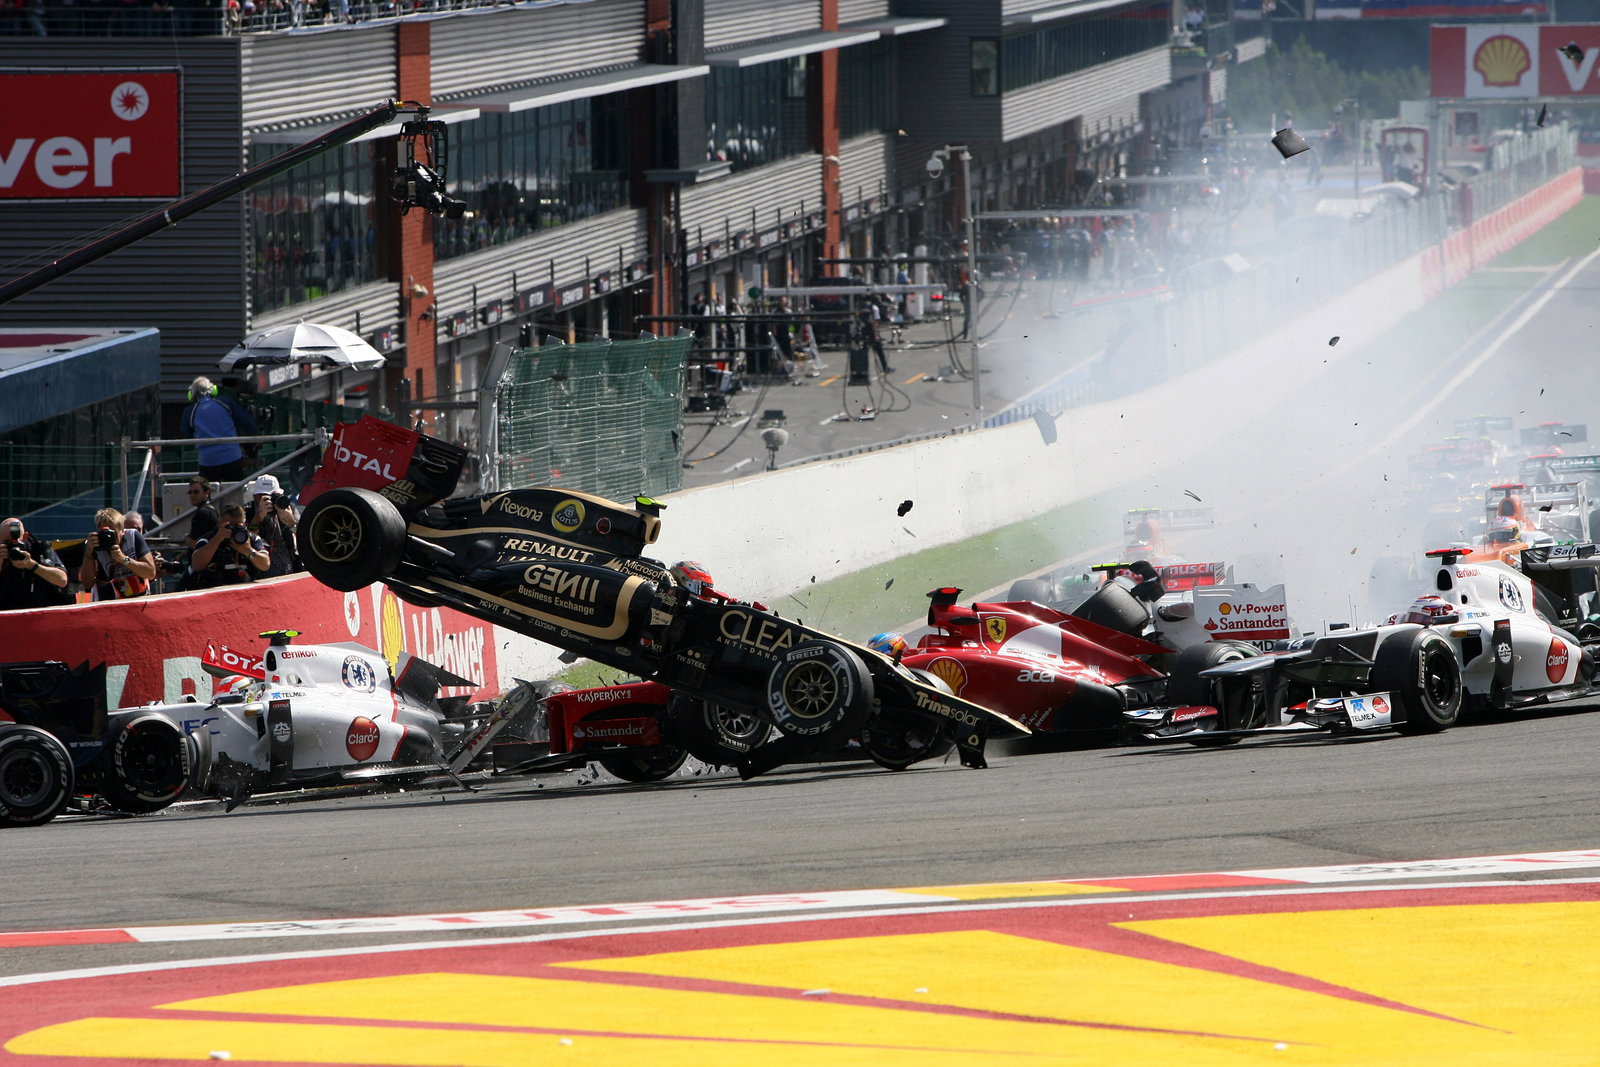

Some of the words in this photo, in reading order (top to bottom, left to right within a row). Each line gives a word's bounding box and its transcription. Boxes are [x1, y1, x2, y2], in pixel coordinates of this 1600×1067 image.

[333, 439, 397, 482] TOTAL
[499, 497, 543, 523] Rexona
[556, 512, 579, 526] LOTUS
[504, 537, 595, 564] RENAULT
[623, 558, 667, 582] Microsoft
[523, 564, 600, 604] GENII
[518, 584, 553, 604] Business
[554, 597, 595, 616] Exchange
[1233, 603, 1285, 614] V-Power
[719, 609, 815, 653] CLEA
[1219, 615, 1286, 631] Santander
[787, 645, 824, 663] PIRELLI
[686, 658, 707, 671] STEEL
[1017, 669, 1057, 683] acer
[576, 689, 627, 704] KASPERSKY
[915, 690, 981, 728] Trinasolar
[784, 720, 832, 735] ZERO
[1350, 713, 1378, 724] TELMEX
[348, 731, 374, 745] Claro
[586, 722, 645, 743] Santander
